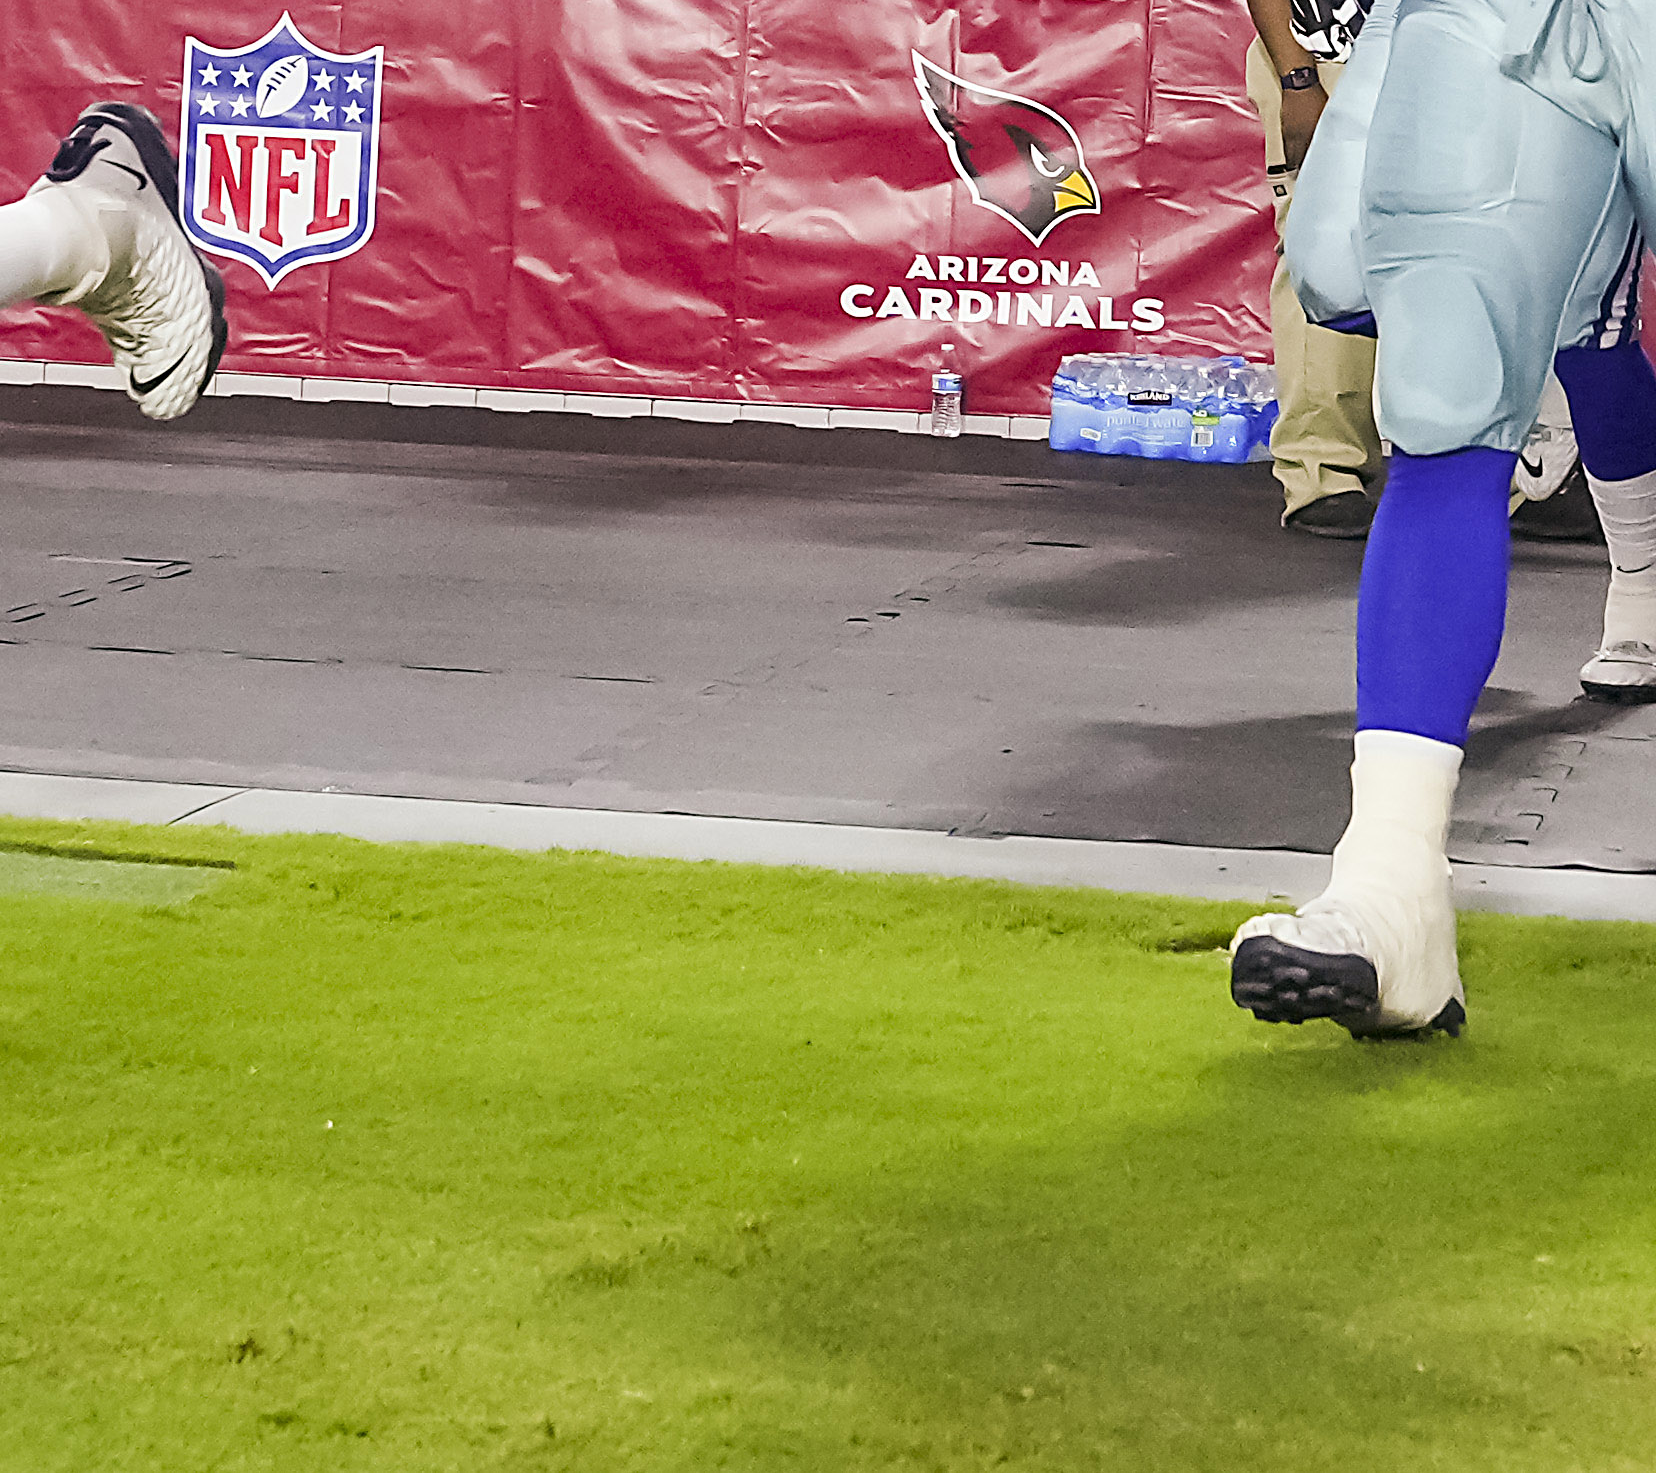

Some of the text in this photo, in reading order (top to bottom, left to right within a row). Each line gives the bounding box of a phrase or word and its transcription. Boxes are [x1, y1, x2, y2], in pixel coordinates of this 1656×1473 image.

[202, 131, 353, 247] NFL
[904, 252, 1103, 288] ARIZONA
[839, 283, 1166, 333] CARDINALS
